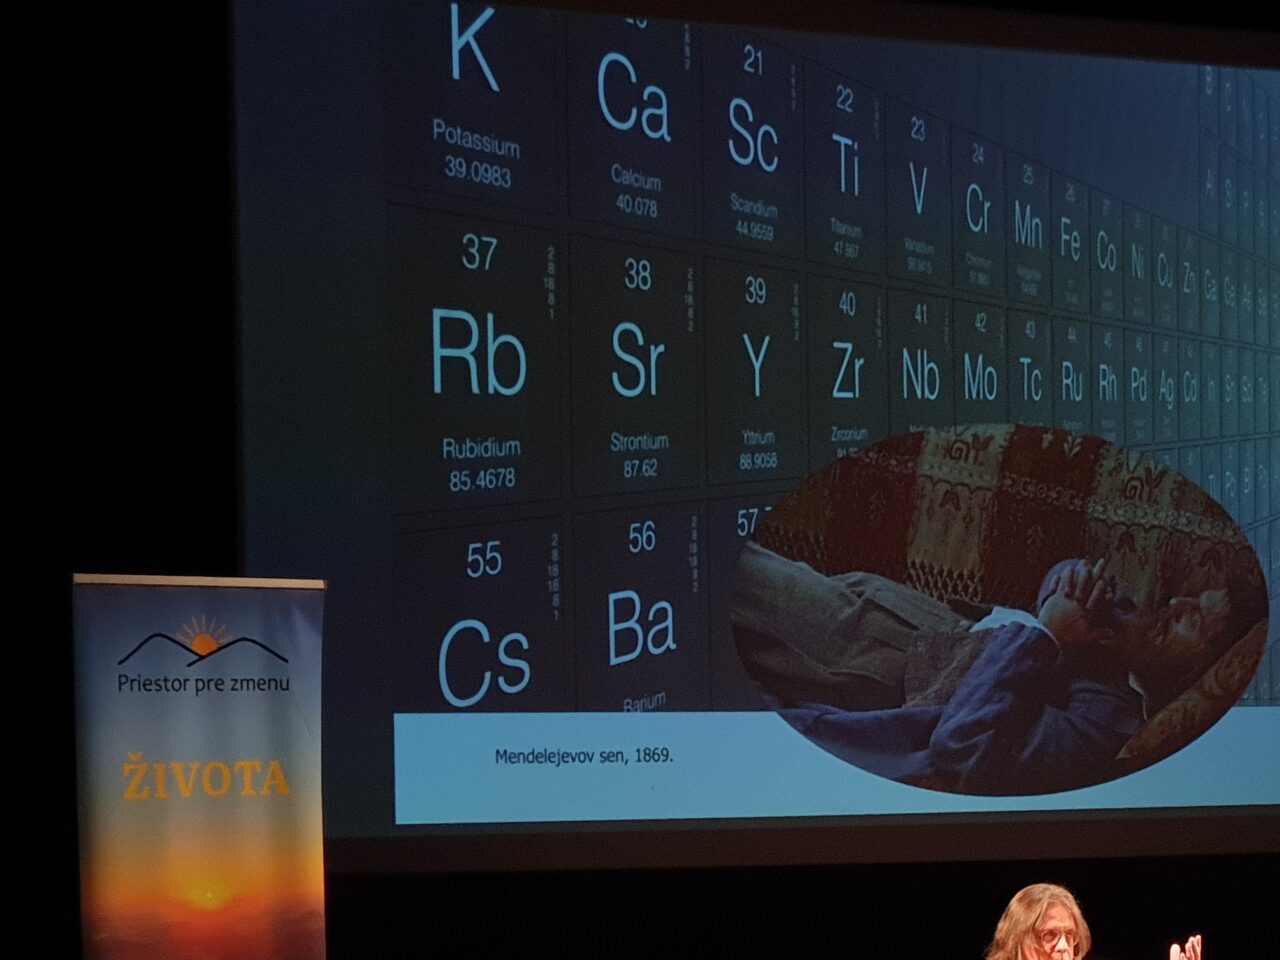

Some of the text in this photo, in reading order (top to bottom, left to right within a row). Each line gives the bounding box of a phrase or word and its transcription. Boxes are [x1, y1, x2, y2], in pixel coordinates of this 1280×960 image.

[451, 3, 500, 92] K
[744, 44, 762, 76] 21
[597, 52, 671, 142] Ca
[836, 84, 854, 112] 22
[432, 118, 521, 159] Potassium
[728, 97, 778, 173] Sc
[911, 116, 925, 142] 23
[444, 155, 511, 188] 39.0983
[610, 163, 662, 191] Calcium
[832, 133, 861, 197] Ti
[616, 193, 658, 218] 40.078
[909, 161, 928, 215] V
[966, 183, 991, 234] Cr
[1015, 199, 1042, 250] Mn
[462, 233, 498, 270] 37
[1061, 216, 1081, 261] Fe
[1097, 230, 1117, 272] Co
[624, 257, 651, 291] 38
[745, 276, 767, 304] 39
[838, 292, 856, 317] 40
[915, 303, 928, 324] 41
[432, 308, 527, 395] Rb
[611, 321, 665, 398] Sr
[742, 333, 771, 397] Y
[832, 342, 865, 398] Zr
[902, 347, 941, 400] Nb
[964, 352, 998, 400] Mo
[1019, 357, 1042, 401] Tc
[1062, 361, 1083, 401] Ru
[1100, 364, 1117, 401] Rh
[1131, 367, 1147, 401] Pd
[1159, 370, 1174, 410] Ag
[442, 437, 521, 459] Rubidium
[610, 432, 669, 451] Strontium
[449, 467, 516, 491] 85.4678
[623, 458, 658, 478] 87.62
[628, 520, 656, 553] 56
[466, 540, 503, 578] 55
[608, 589, 678, 667] Ba
[438, 618, 532, 708] Cs
[118, 674, 290, 697] Priestor pre zmenu
[122, 751, 291, 801] ŽIVOTA
[495, 747, 674, 768] Mendelejevov sen, 1869.
